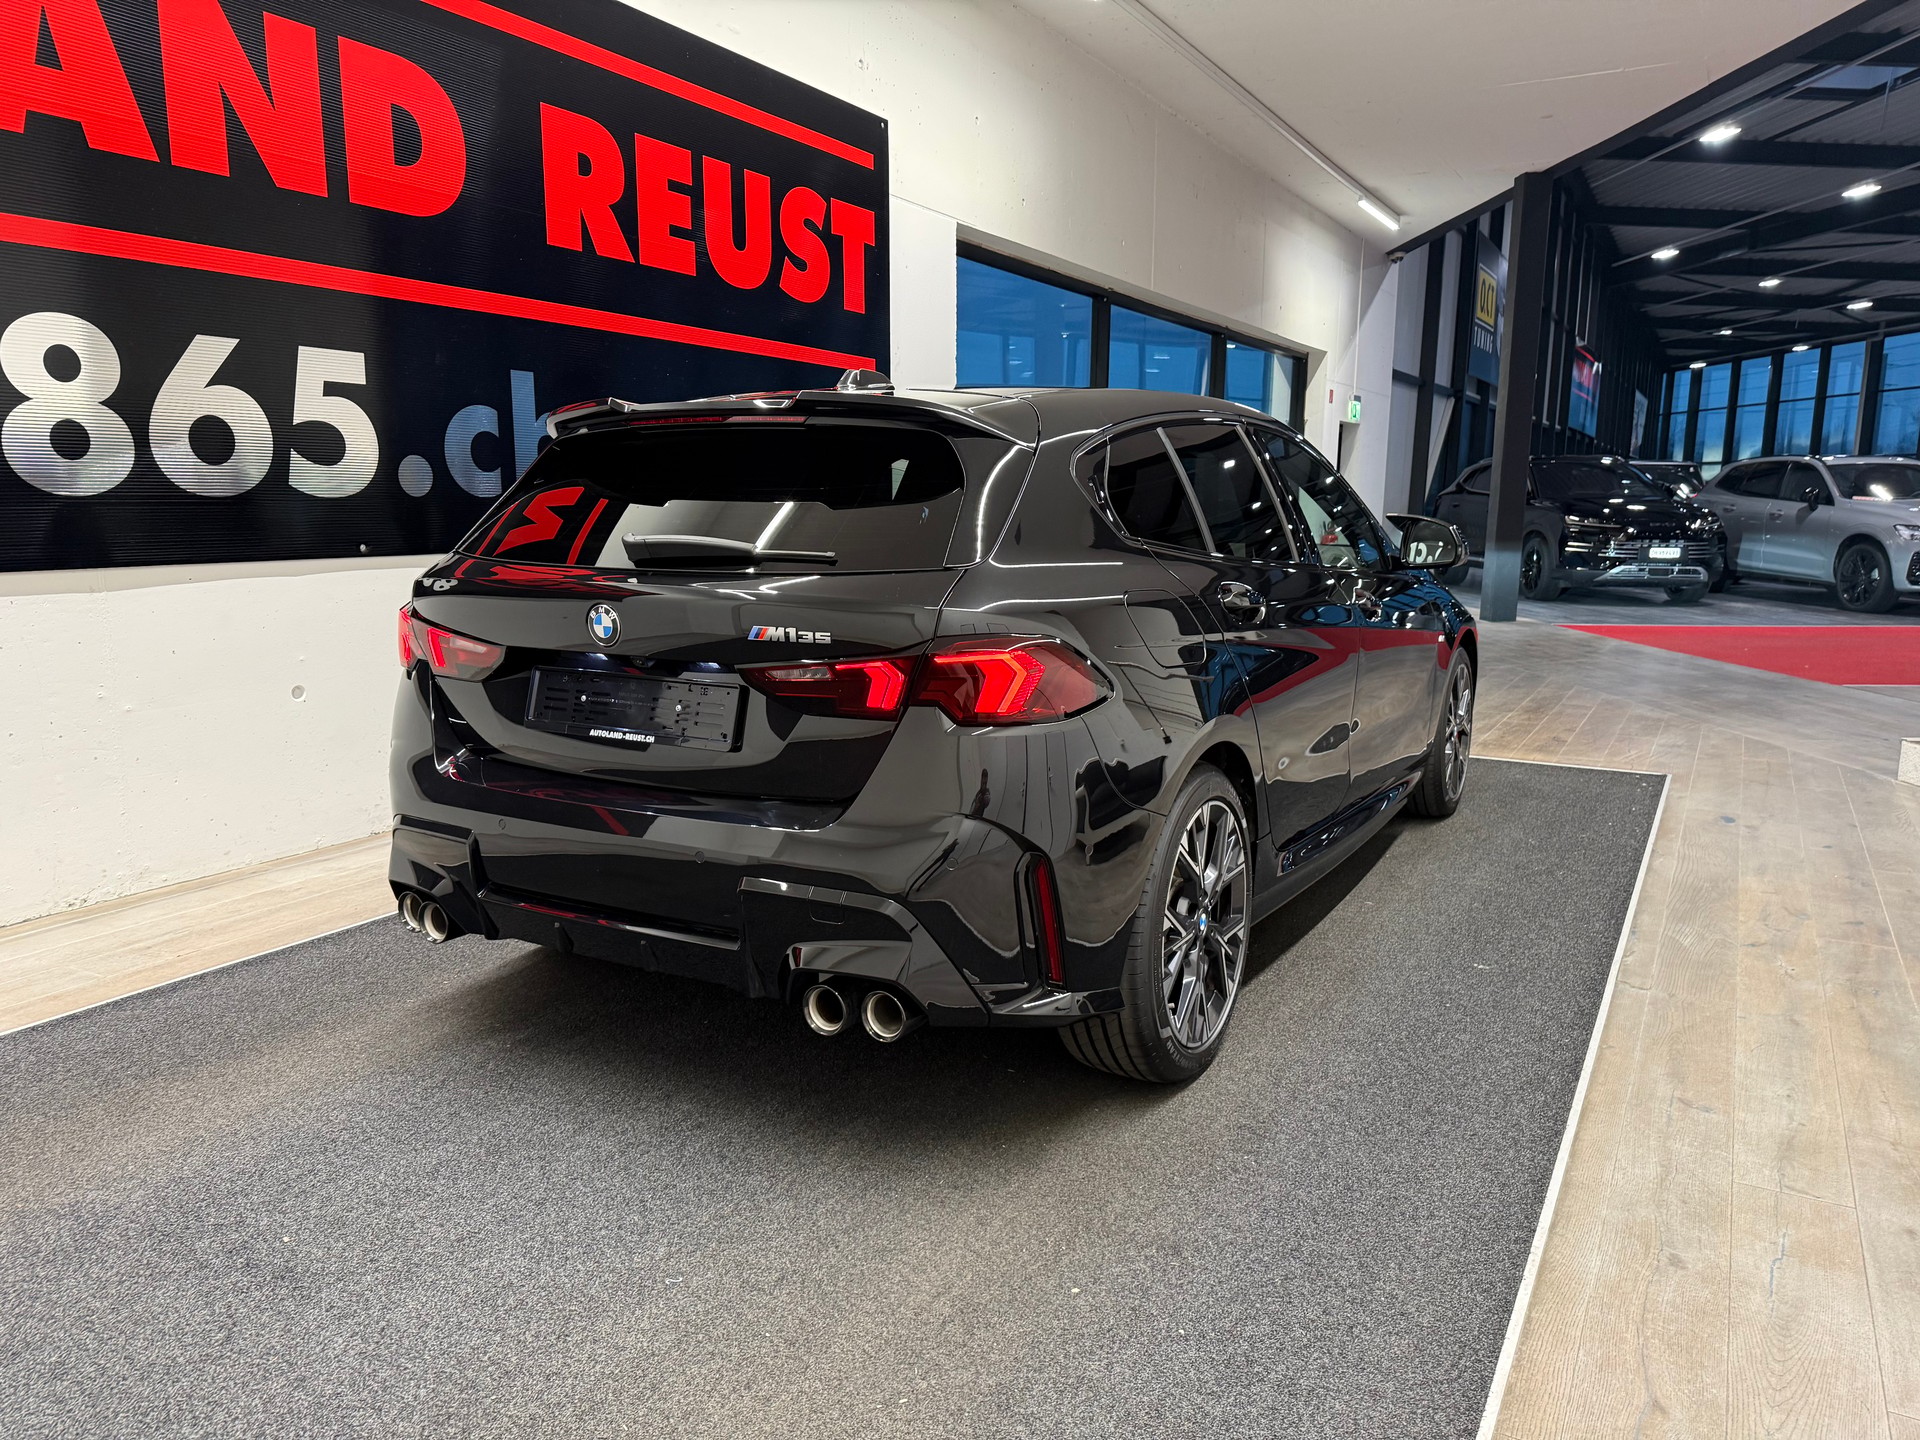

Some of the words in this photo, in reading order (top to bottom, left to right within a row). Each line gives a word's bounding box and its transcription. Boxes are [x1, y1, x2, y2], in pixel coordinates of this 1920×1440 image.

[0, 0, 466, 217] AND
[540, 102, 875, 314] REUST
[590, 606, 616, 620] BMW
[763, 626, 831, 644] M135
[589, 728, 655, 743] AUTOLAND-REUST.CH
